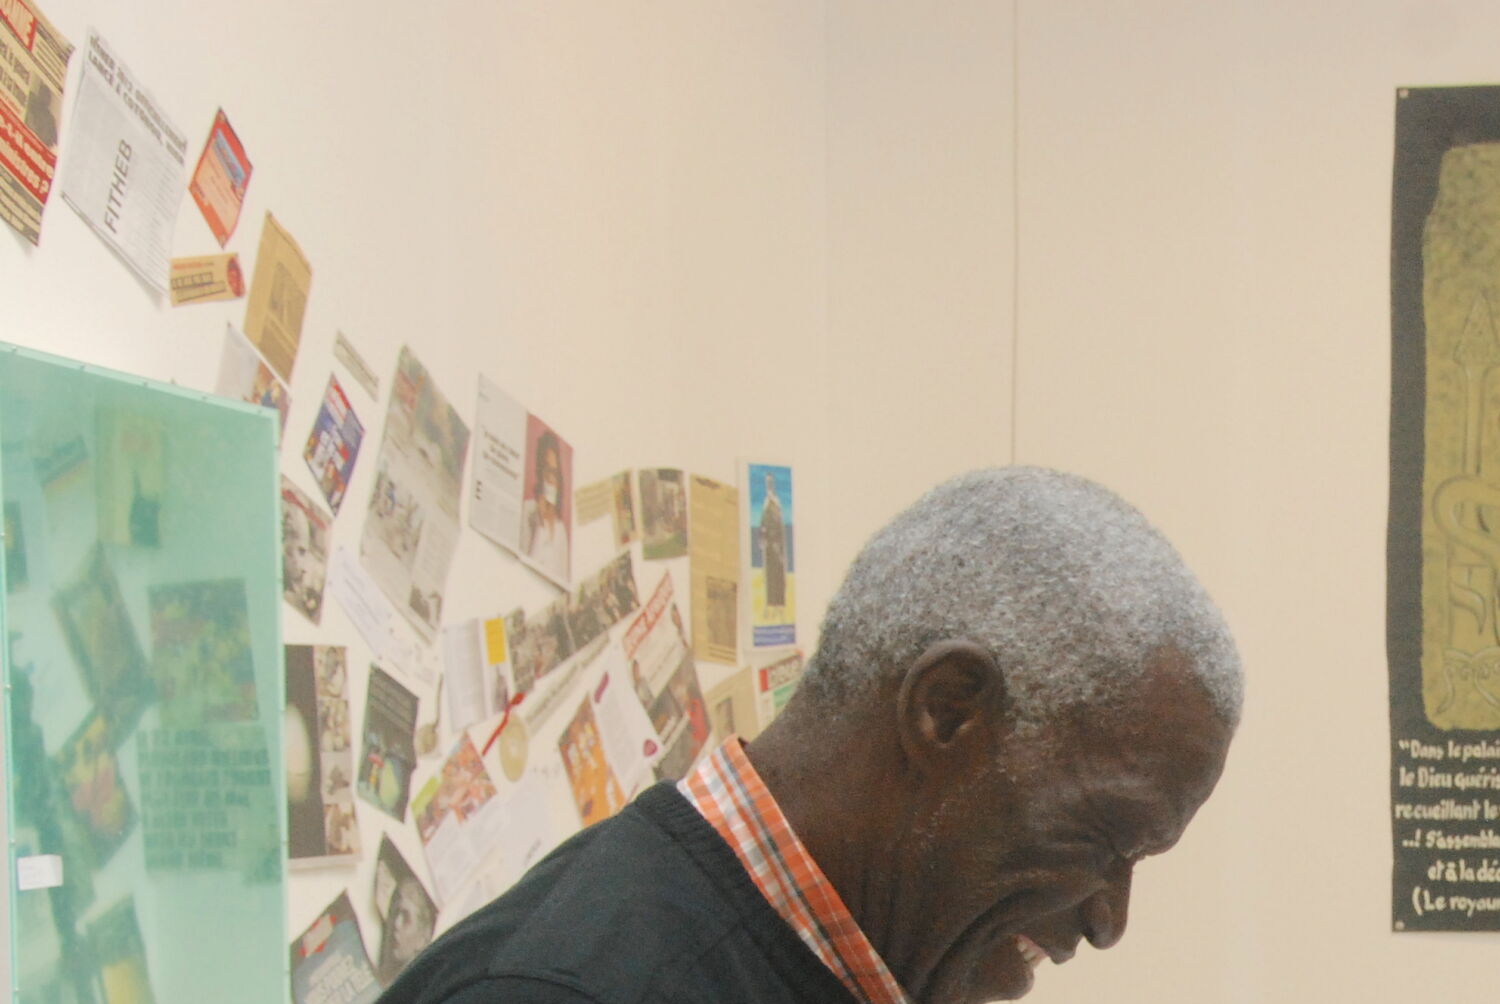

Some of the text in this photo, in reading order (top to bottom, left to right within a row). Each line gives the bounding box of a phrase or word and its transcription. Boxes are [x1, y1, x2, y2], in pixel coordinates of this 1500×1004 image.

[104, 138, 133, 235] FITHEB
[1448, 740, 1461, 758] le
[1399, 766, 1415, 787] le
[1417, 766, 1452, 788] Dieu
[1395, 799, 1481, 820] recueillant
[1484, 799, 1500, 820] le
[1427, 860, 1445, 880] et
[1459, 859, 1475, 881] la
[1412, 886, 1446, 916] (Le
